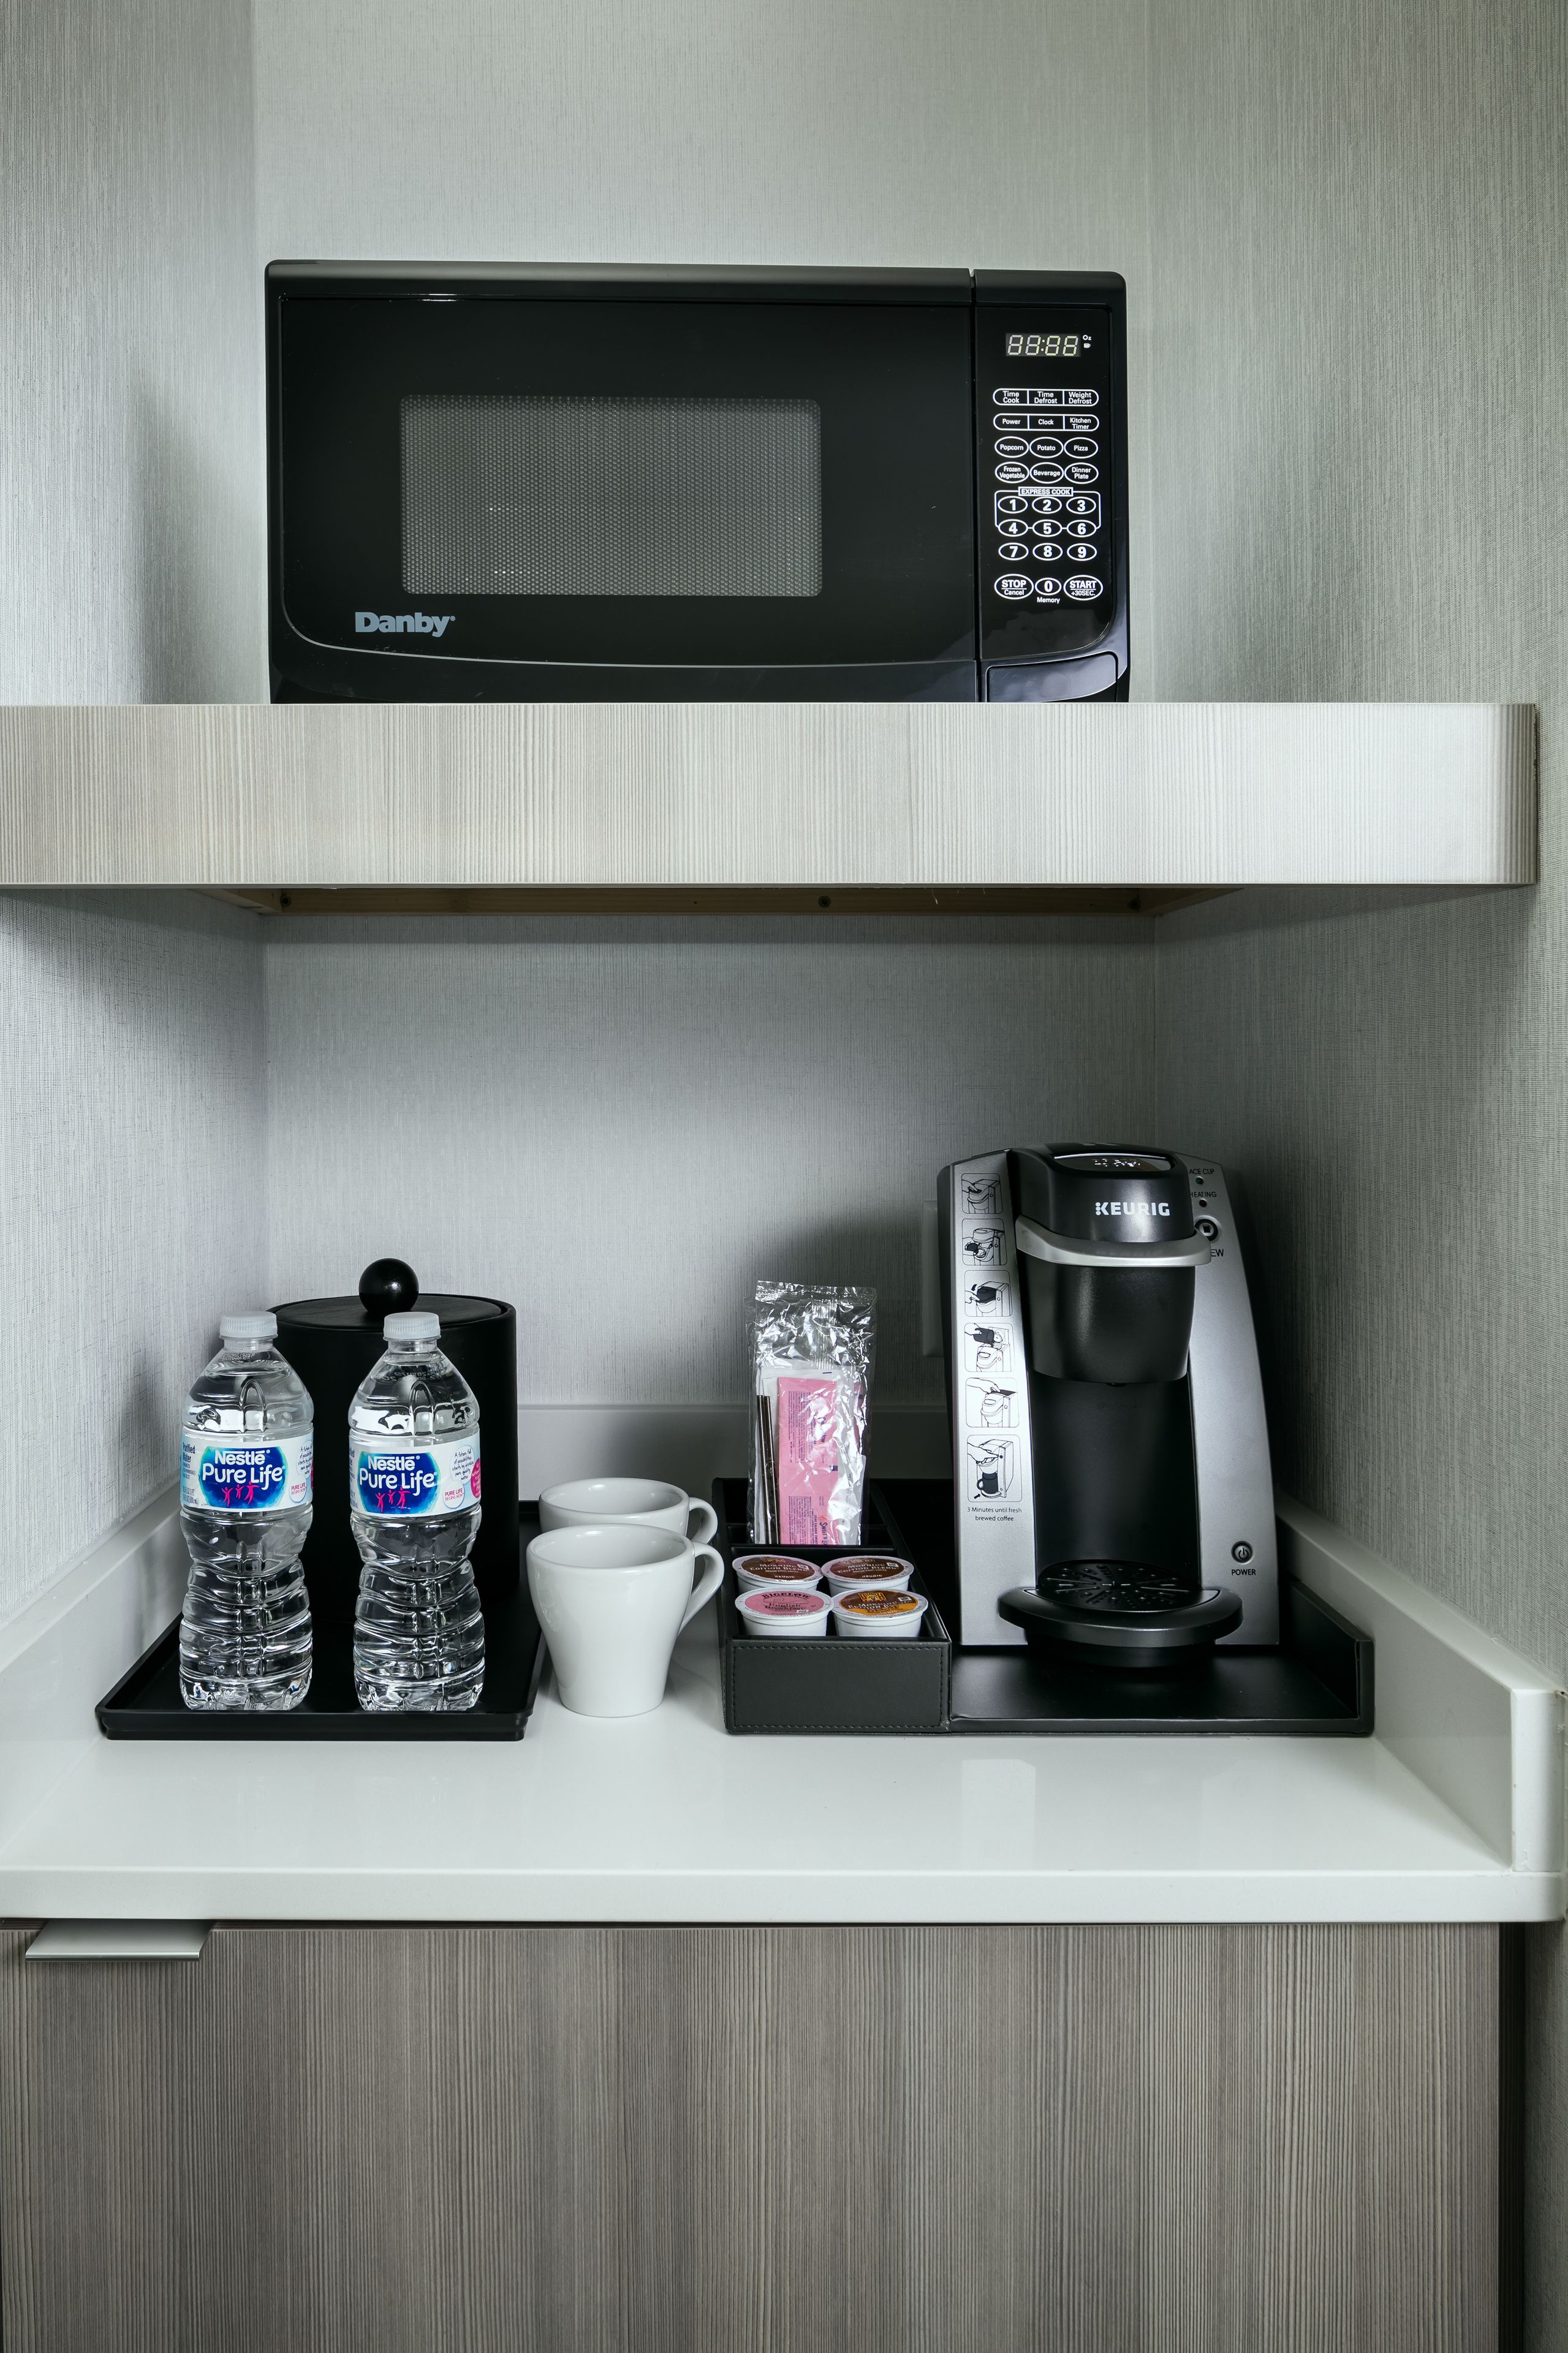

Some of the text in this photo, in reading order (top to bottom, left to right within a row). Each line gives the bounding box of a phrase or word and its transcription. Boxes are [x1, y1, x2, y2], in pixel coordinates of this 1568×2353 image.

[1009, 499, 1017, 510] 1
[1042, 499, 1051, 511] 2
[1077, 500, 1086, 512] 3
[1009, 523, 1018, 534] 4
[1043, 523, 1051, 534] 5
[1077, 523, 1086, 535] 6
[1009, 546, 1018, 558] 7
[1043, 545, 1052, 558] 8
[1078, 546, 1086, 558] 9
[1044, 580, 1053, 593] 0
[355, 612, 450, 637] Danby
[1095, 1202, 1170, 1216] KEURIG
[202, 1463, 282, 1490] Pure Life
[359, 1468, 434, 1496] Pure Life
